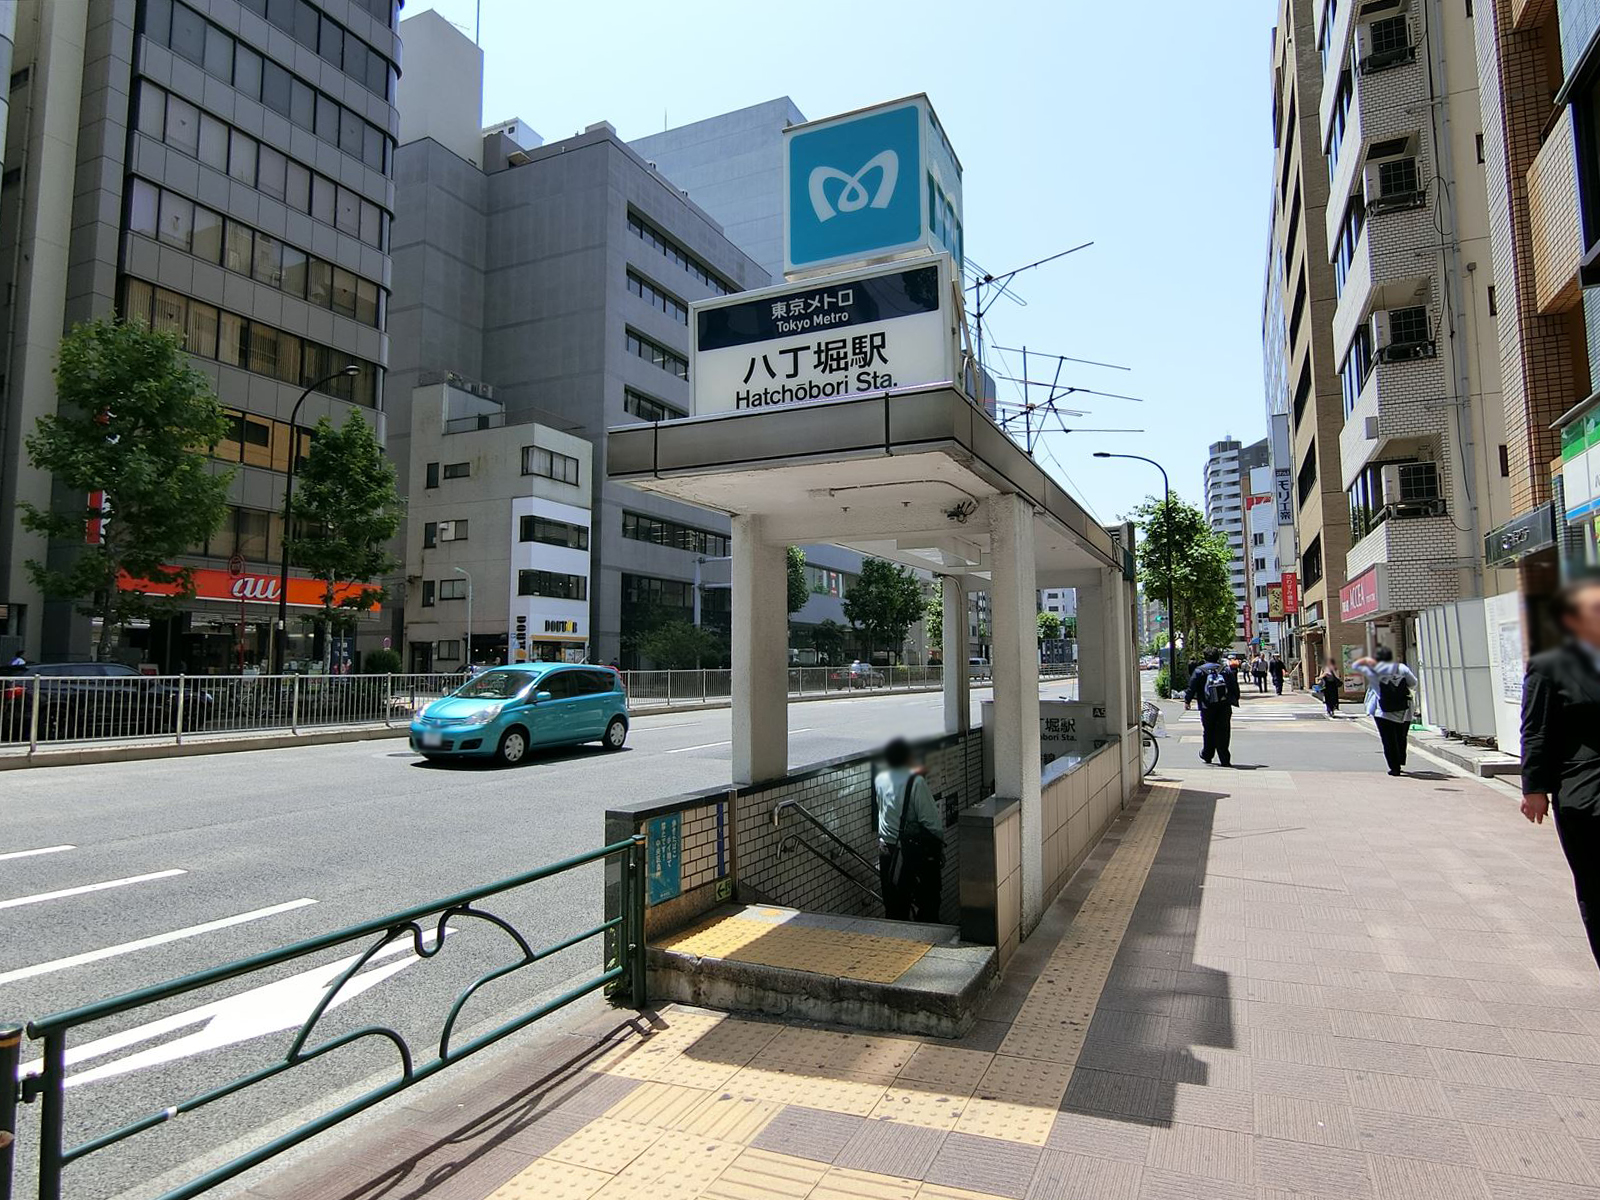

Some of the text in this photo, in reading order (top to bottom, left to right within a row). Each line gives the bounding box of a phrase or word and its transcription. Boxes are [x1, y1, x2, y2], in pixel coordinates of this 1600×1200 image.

[771, 289, 853, 320] 東京メトロ
[776, 311, 849, 333] Tokyo Metro
[743, 332, 889, 384] 八丁堀駅
[736, 371, 898, 409] Hatchōbori Sta.
[232, 577, 281, 599] au
[545, 620, 578, 633] DOUTOR
[1040, 717, 1076, 733] 堀駅
[1061, 733, 1078, 742] Sta.
